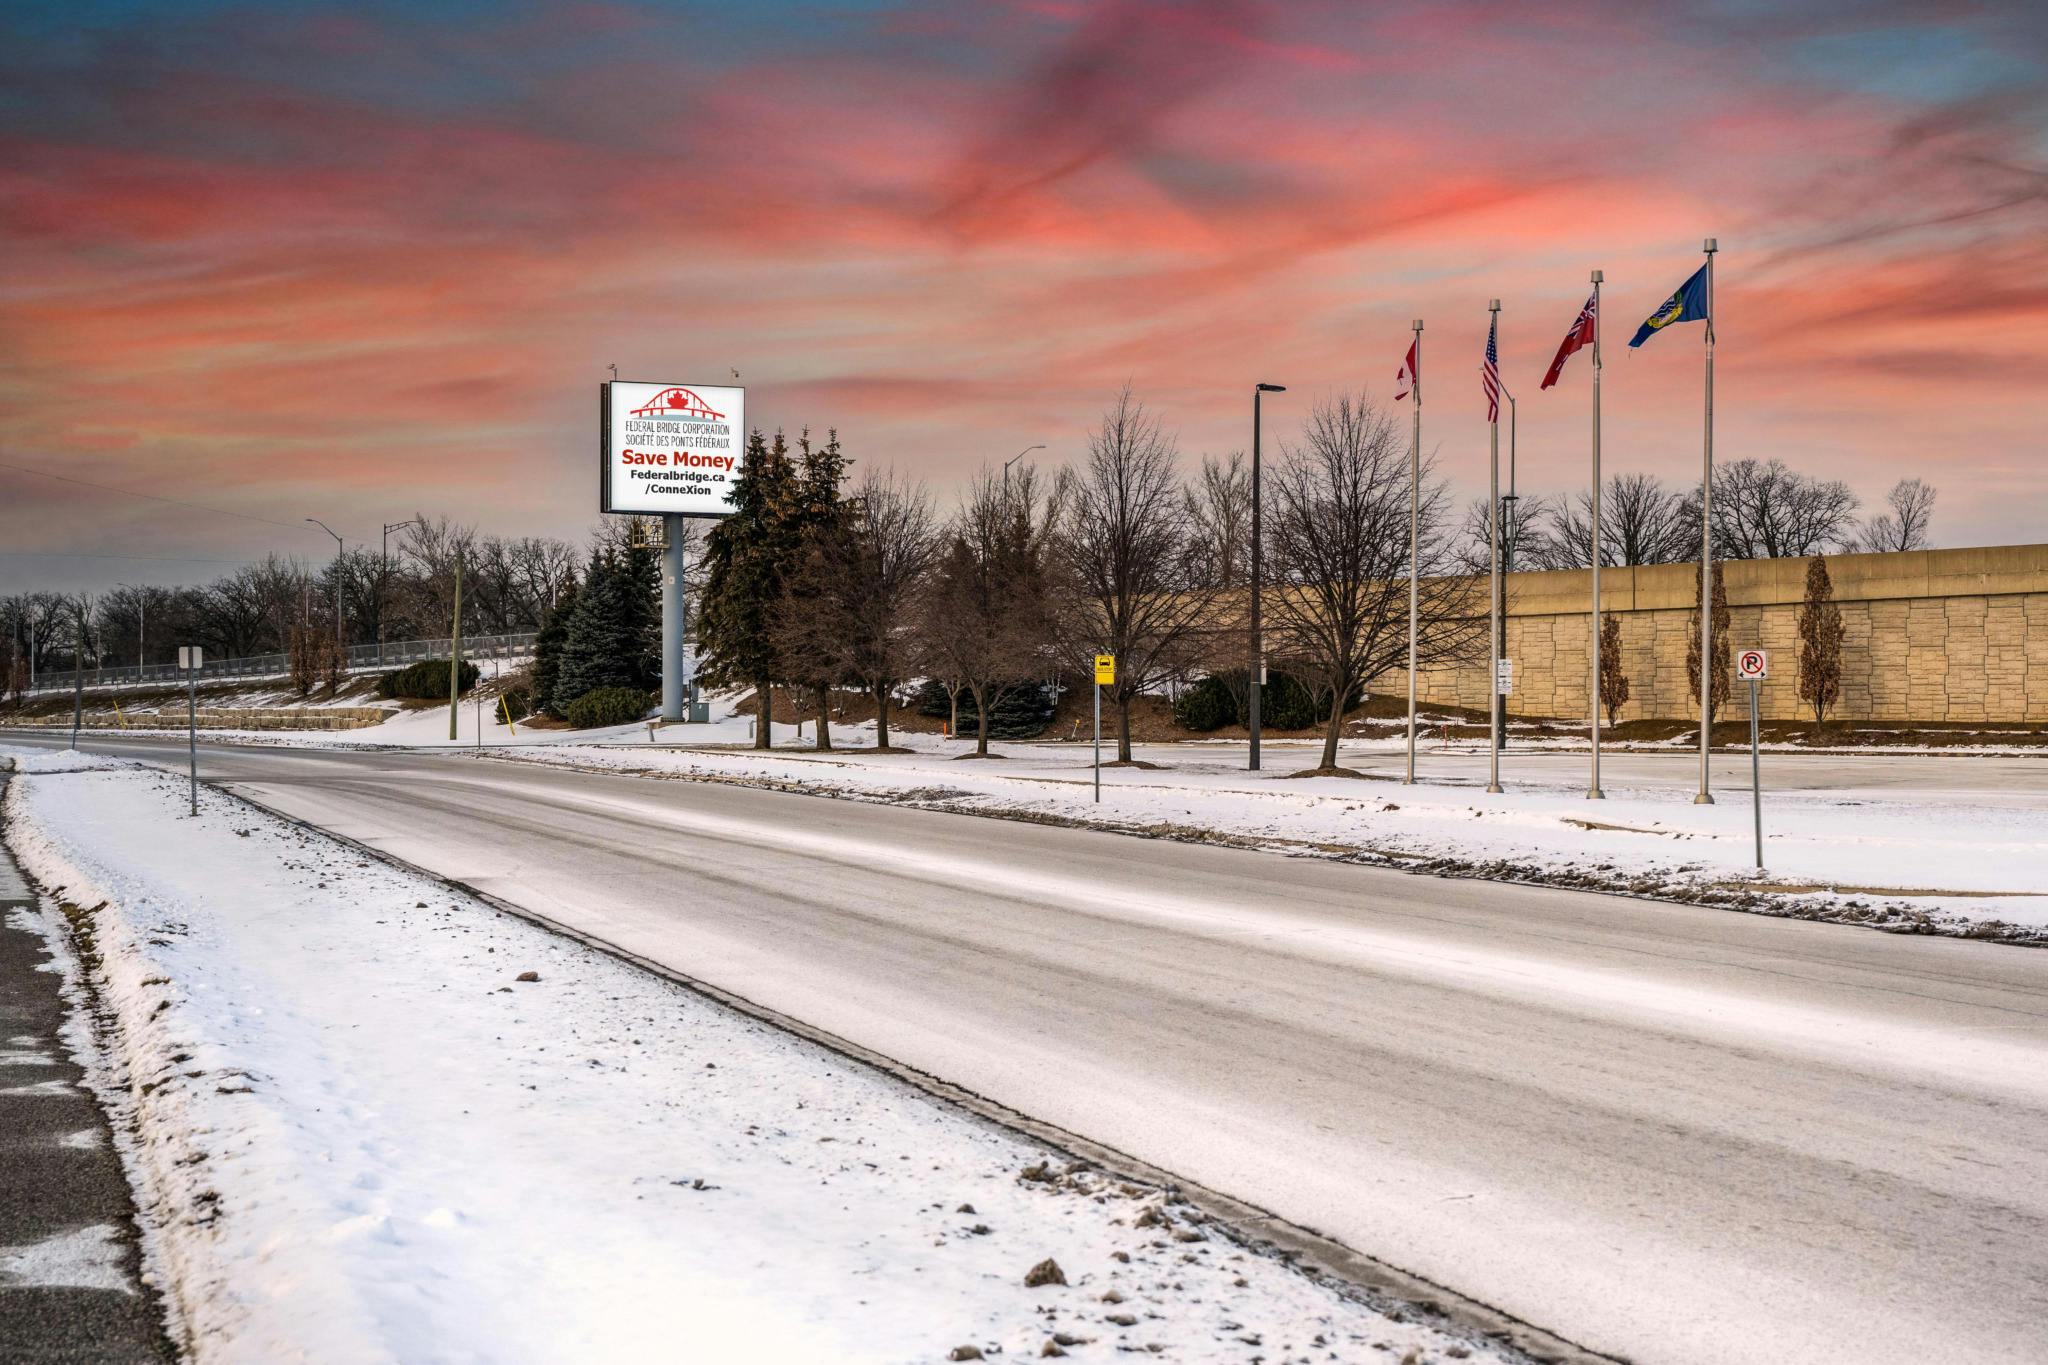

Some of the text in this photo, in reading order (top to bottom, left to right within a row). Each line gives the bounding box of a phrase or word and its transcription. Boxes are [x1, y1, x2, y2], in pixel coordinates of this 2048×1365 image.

[625, 421, 730, 435] FEDERAL BRIDGE CORPORATION
[625, 433, 730, 448] SOCIÉTÉ DES PONTS FÉDÉRAUX
[622, 449, 734, 471] Save Money
[630, 470, 725, 483] Federalbridge.ca
[645, 484, 711, 495] /ConneXion
